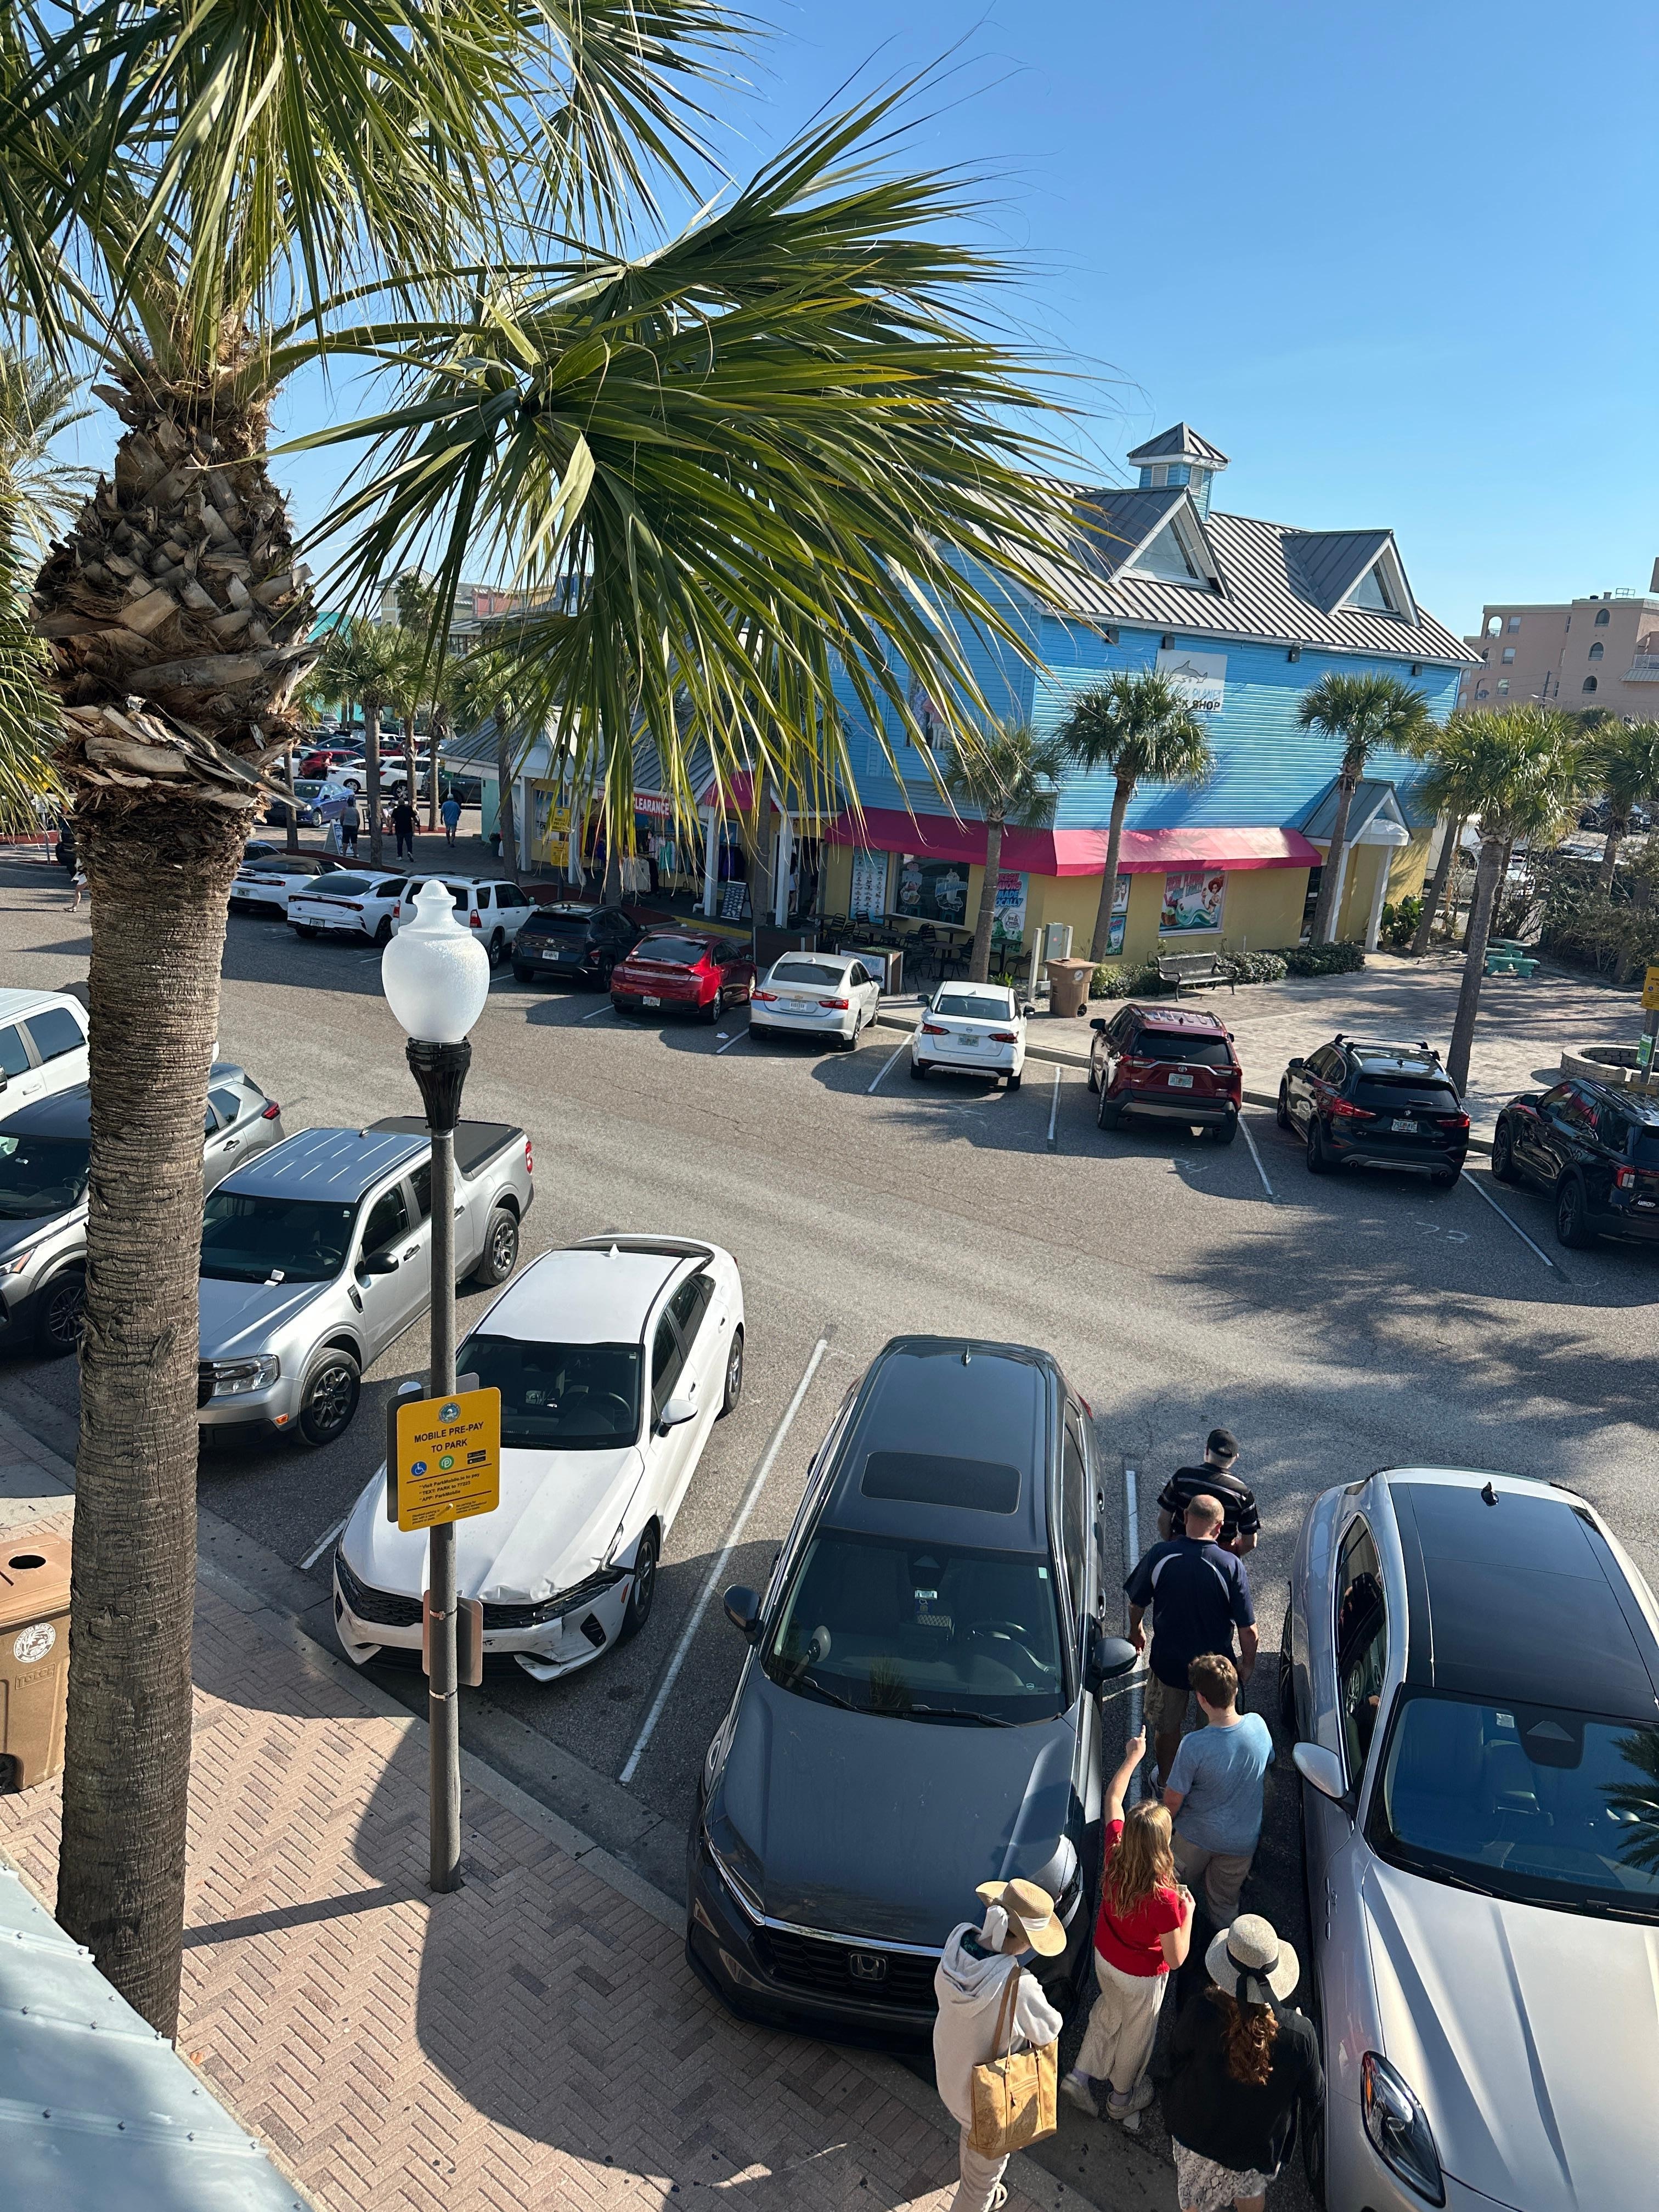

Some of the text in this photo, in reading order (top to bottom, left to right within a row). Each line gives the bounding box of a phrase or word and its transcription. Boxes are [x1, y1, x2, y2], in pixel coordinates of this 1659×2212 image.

[1193, 701, 1220, 710] SHOP
[998, 873, 1020, 882] RESH
[996, 890, 1019, 899] MADE
[995, 898, 1024, 907] OCALLY
[414, 1421, 484, 1443] MOBILE PRE-PAY
[431, 1438, 468, 1453] TO PARK
